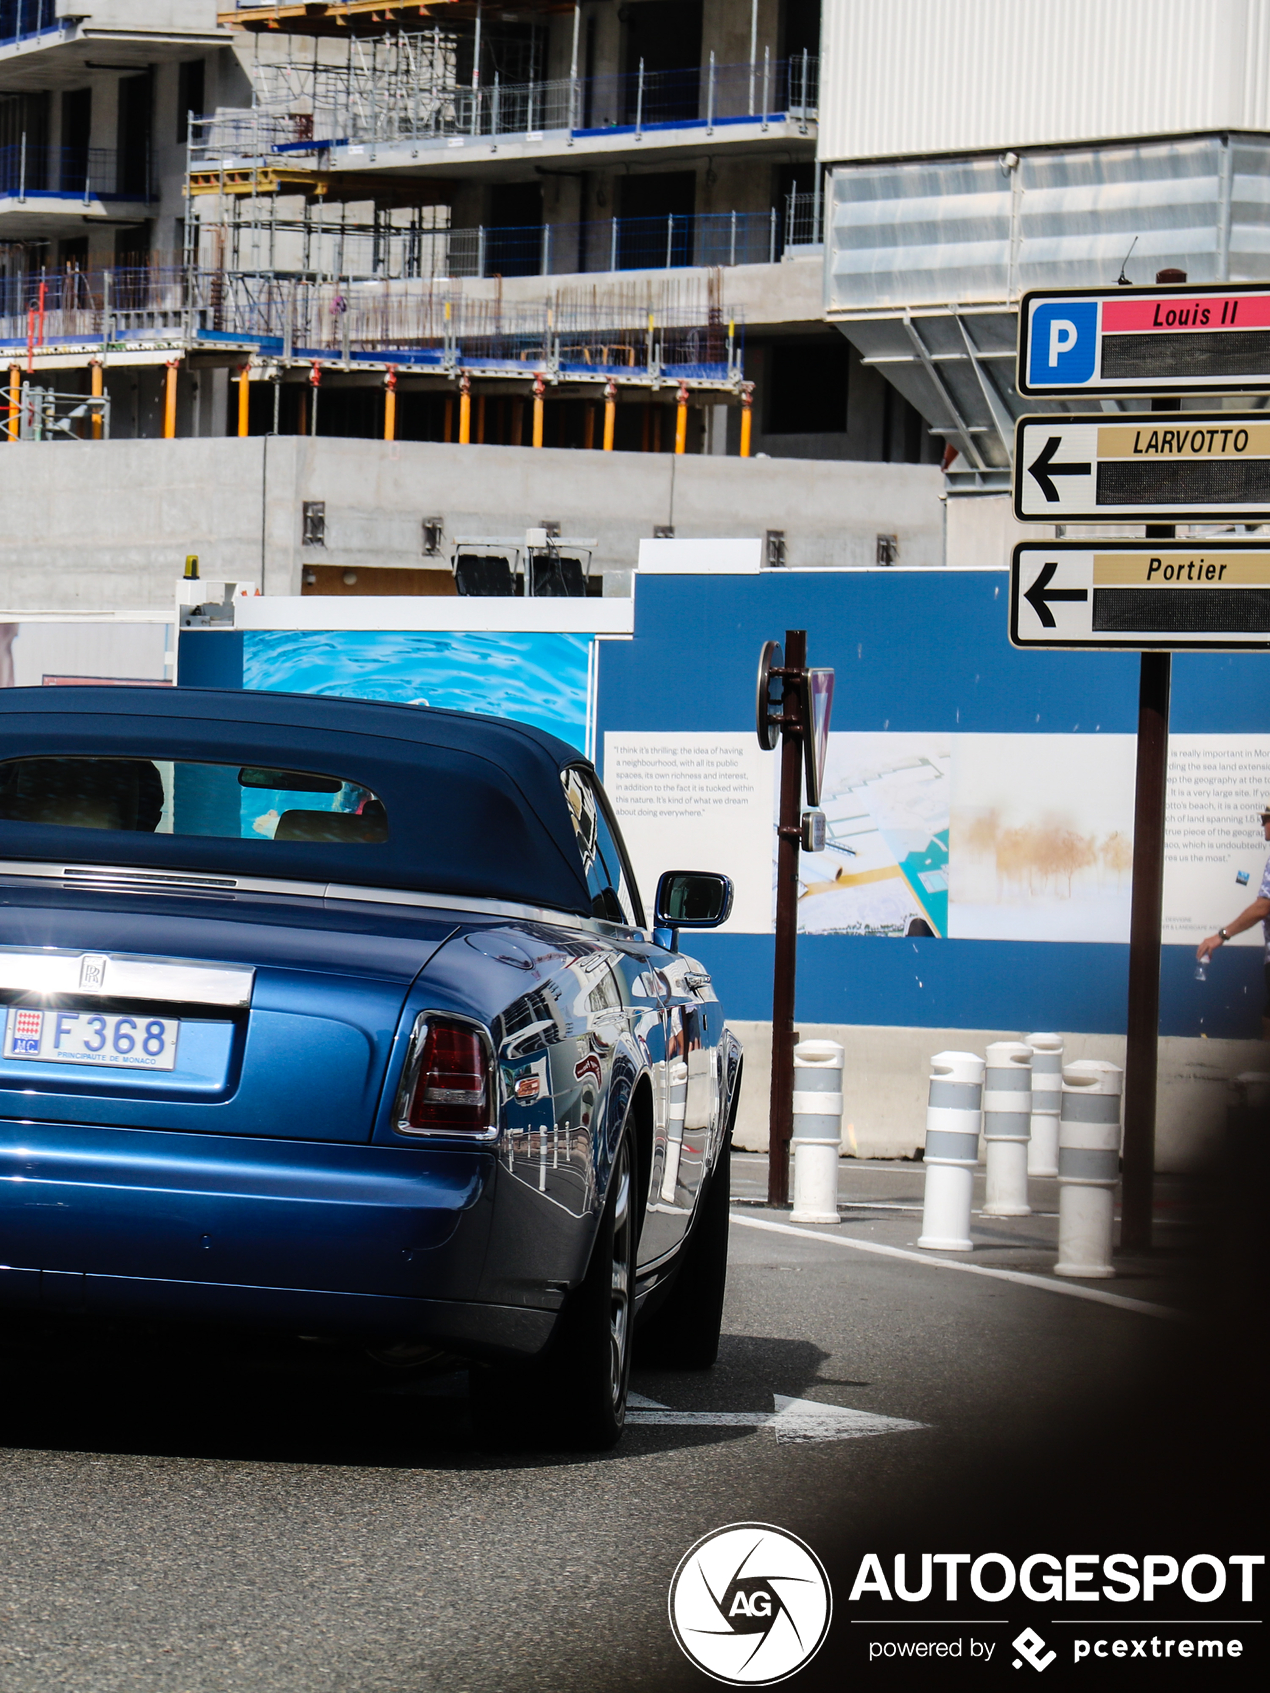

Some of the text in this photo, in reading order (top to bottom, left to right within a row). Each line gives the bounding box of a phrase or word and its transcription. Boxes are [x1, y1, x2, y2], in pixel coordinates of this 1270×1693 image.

[1153, 301, 1238, 327] Louis II
[1049, 319, 1078, 367] P
[1133, 429, 1249, 454] LARVOTTO
[1147, 557, 1227, 581] Portier
[620, 746, 637, 754] think
[650, 747, 679, 756] thrilling:
[720, 747, 743, 756] having
[1171, 749, 1177, 757] is
[1179, 749, 1201, 758] really
[1203, 749, 1243, 758] important
[1245, 749, 1252, 757] in
[622, 759, 678, 768] neighbourhood,
[680, 759, 694, 767] with
[696, 759, 704, 767] all
[716, 760, 738, 769] public
[1167, 762, 1186, 771] ding
[616, 772, 643, 780] spaces,
[719, 772, 748, 780] interest,
[1179, 776, 1192, 784] the
[1194, 776, 1237, 785] geography
[1249, 776, 1262, 784] the
[1193, 790, 1210, 798] very
[1212, 789, 1232, 798] large
[1189, 801, 1216, 810] beach,
[1217, 801, 1222, 809] it
[638, 809, 657, 817] doing
[1206, 815, 1243, 824] spanning
[1183, 828, 1206, 836] piece
[1208, 841, 1214, 849] is
[1215, 841, 1266, 850] undoubtedly
[1191, 854, 1203, 862] the
[16, 1039, 36, 1052] MC
[57, 1051, 106, 1062] PRINCIPAUTE
[123, 1056, 156, 1065] MONACO
